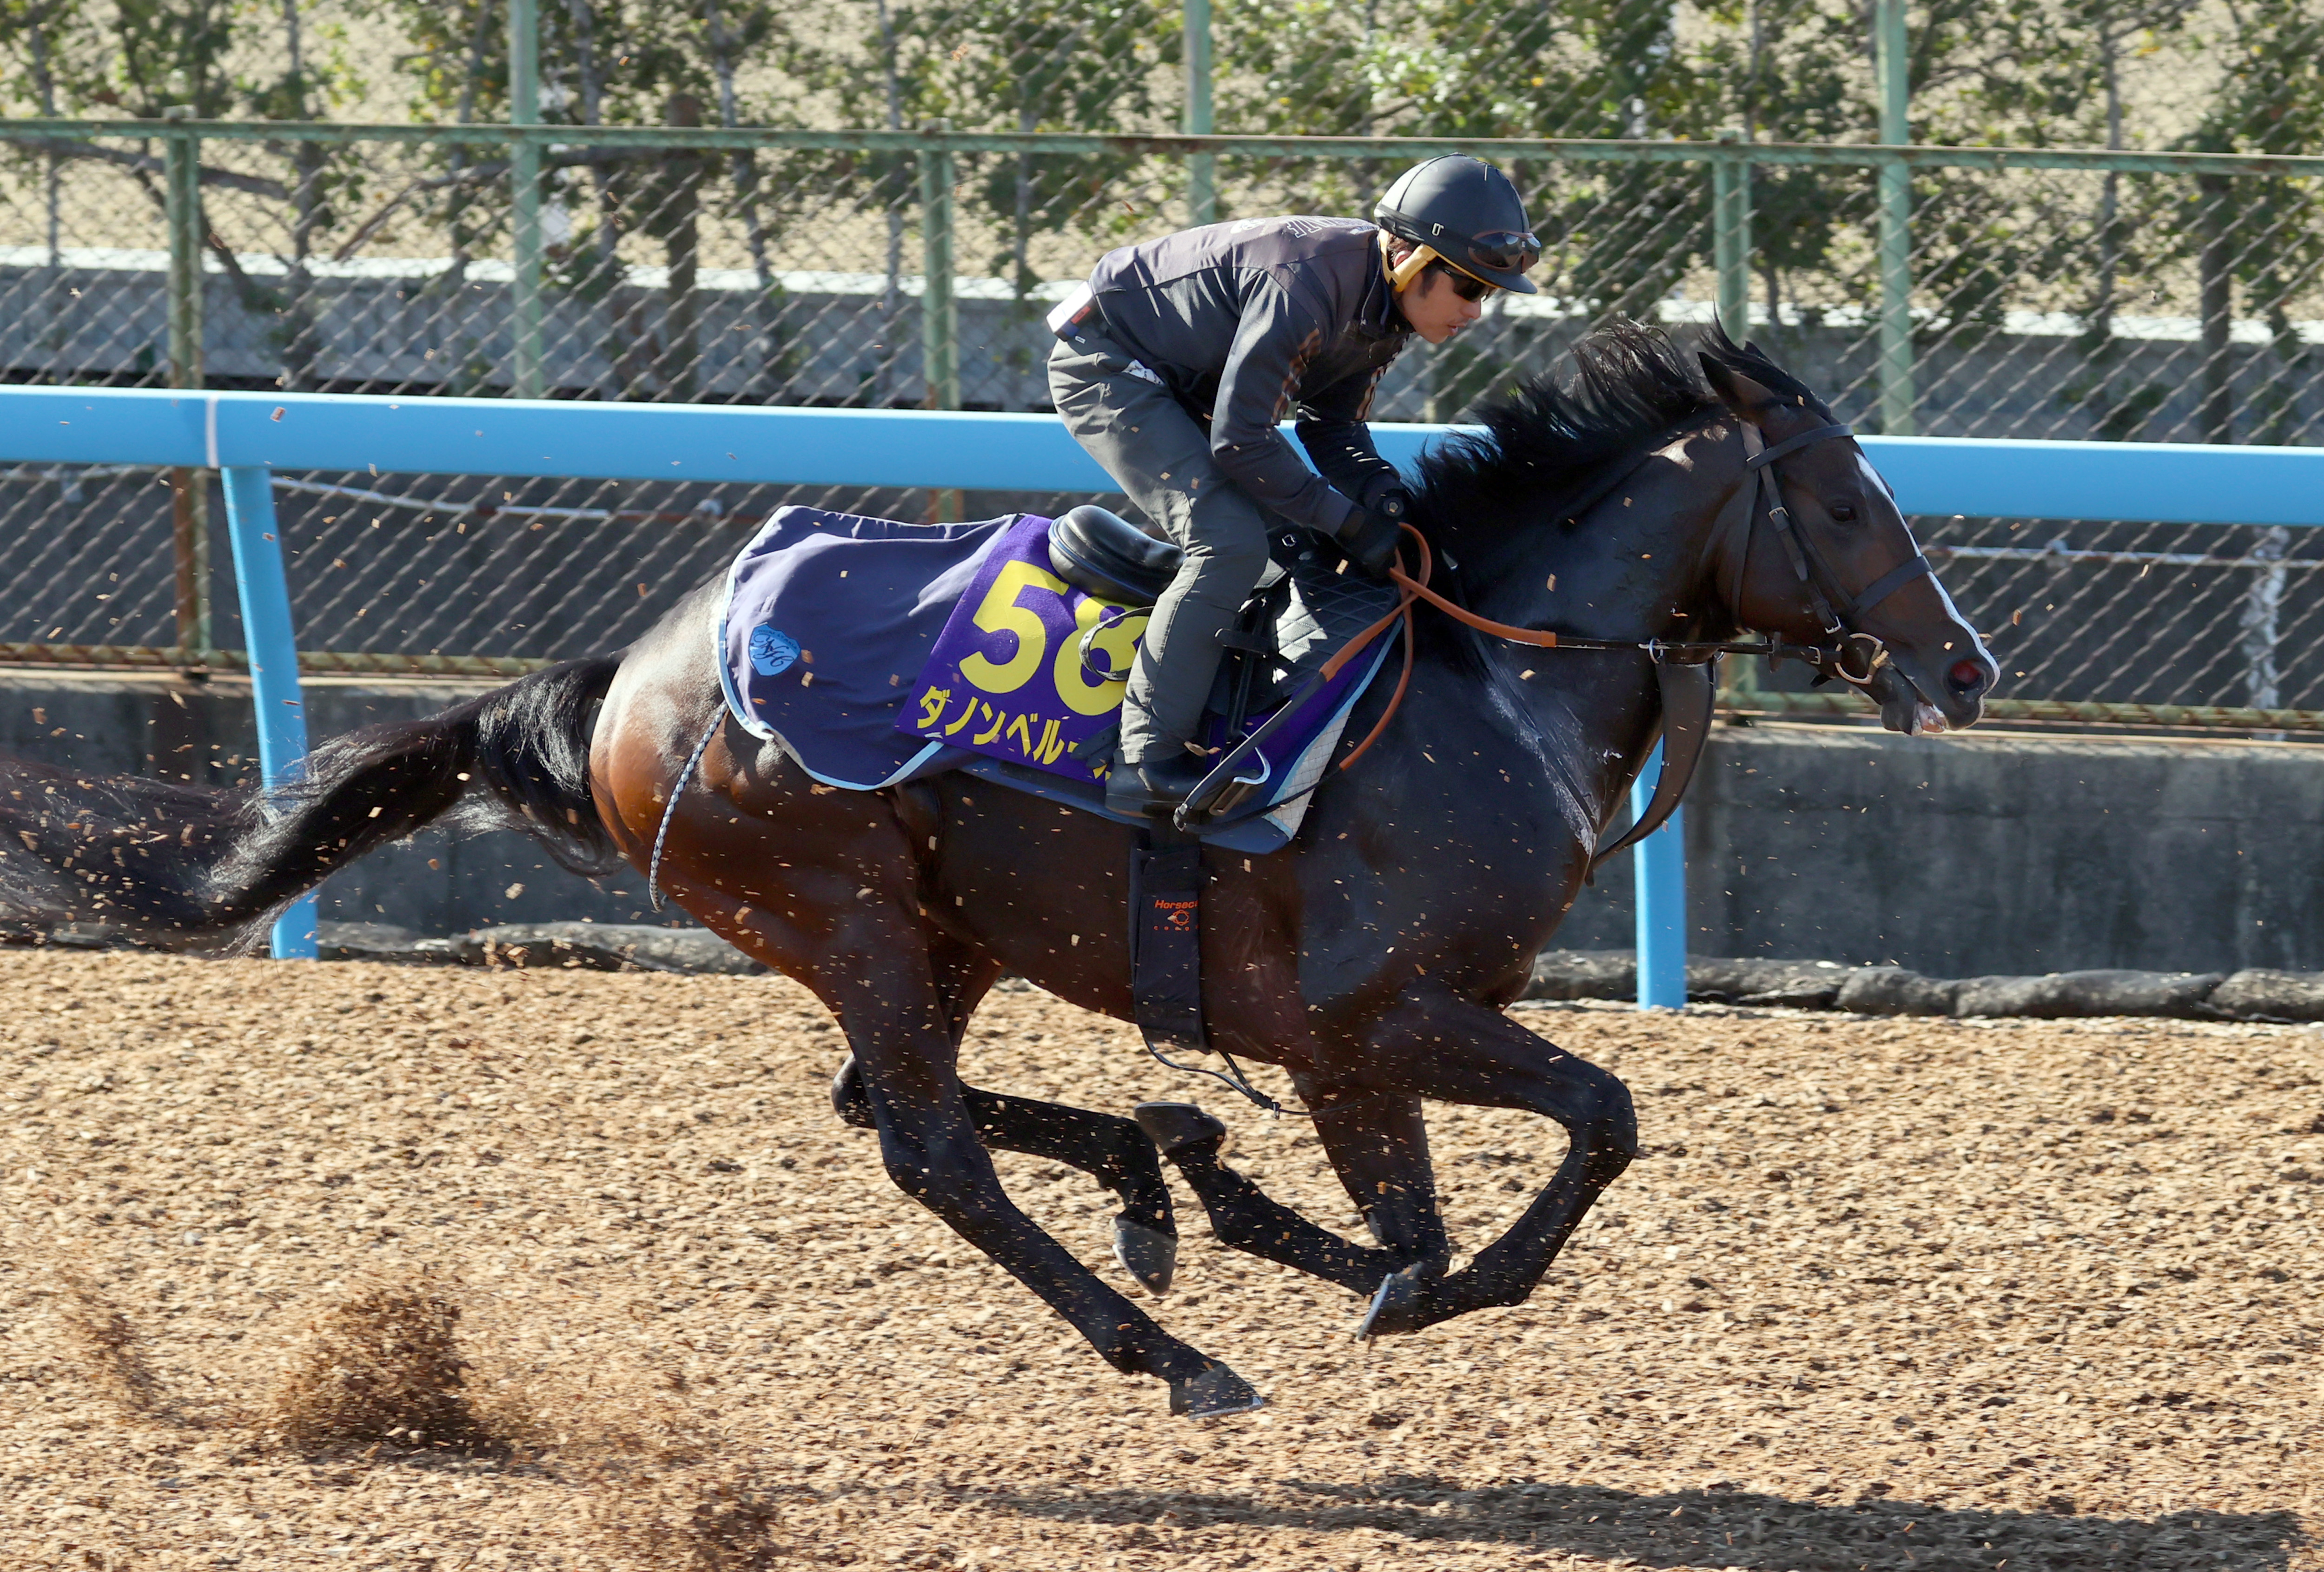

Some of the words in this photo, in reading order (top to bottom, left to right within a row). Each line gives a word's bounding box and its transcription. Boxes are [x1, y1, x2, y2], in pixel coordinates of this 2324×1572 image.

[959, 560, 1151, 716] 58
[917, 685, 1112, 782] ダノンベル
